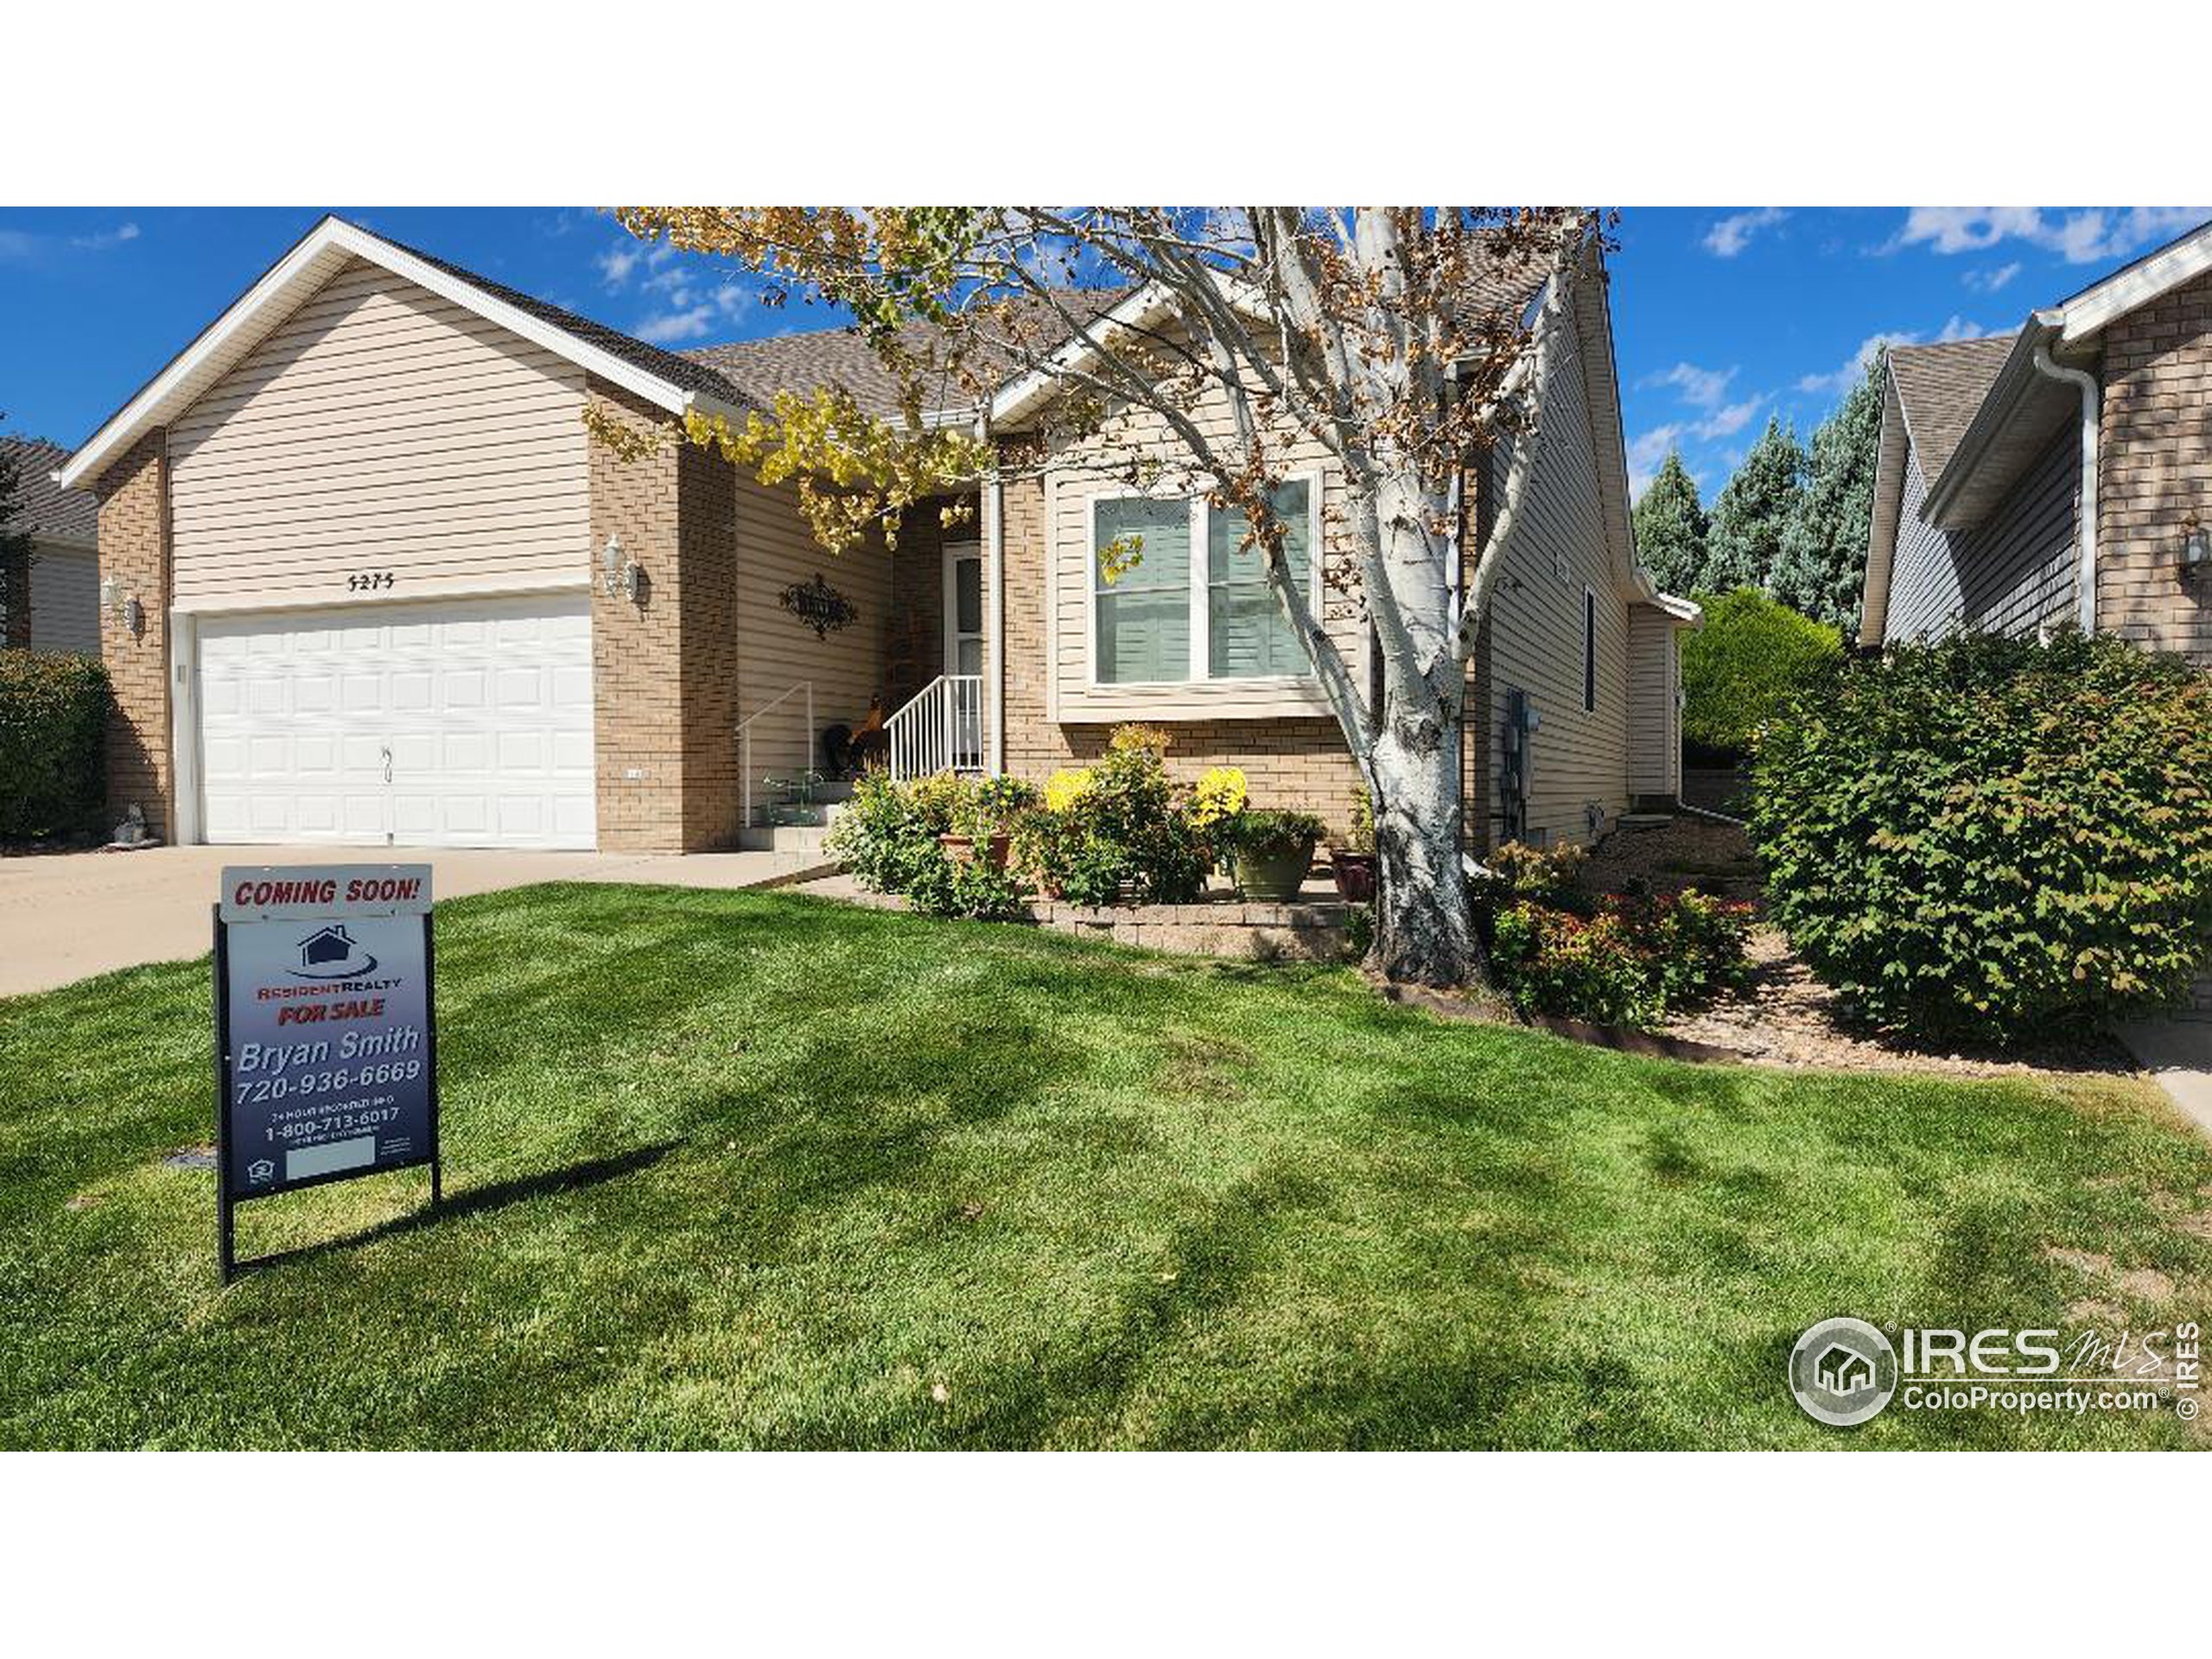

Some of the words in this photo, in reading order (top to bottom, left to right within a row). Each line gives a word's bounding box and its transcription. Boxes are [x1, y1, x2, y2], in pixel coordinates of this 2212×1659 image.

[348, 573, 394, 592] 5275
[235, 880, 337, 906] COMING
[346, 878, 422, 902] SOON!
[278, 1005, 327, 1026] FOR
[329, 999, 386, 1020] SALE
[238, 1041, 328, 1075] Bryan
[340, 1026, 420, 1059] Smith
[236, 1059, 421, 1104] 720-936-6669
[265, 1107, 400, 1141] 1-800-713-6017
